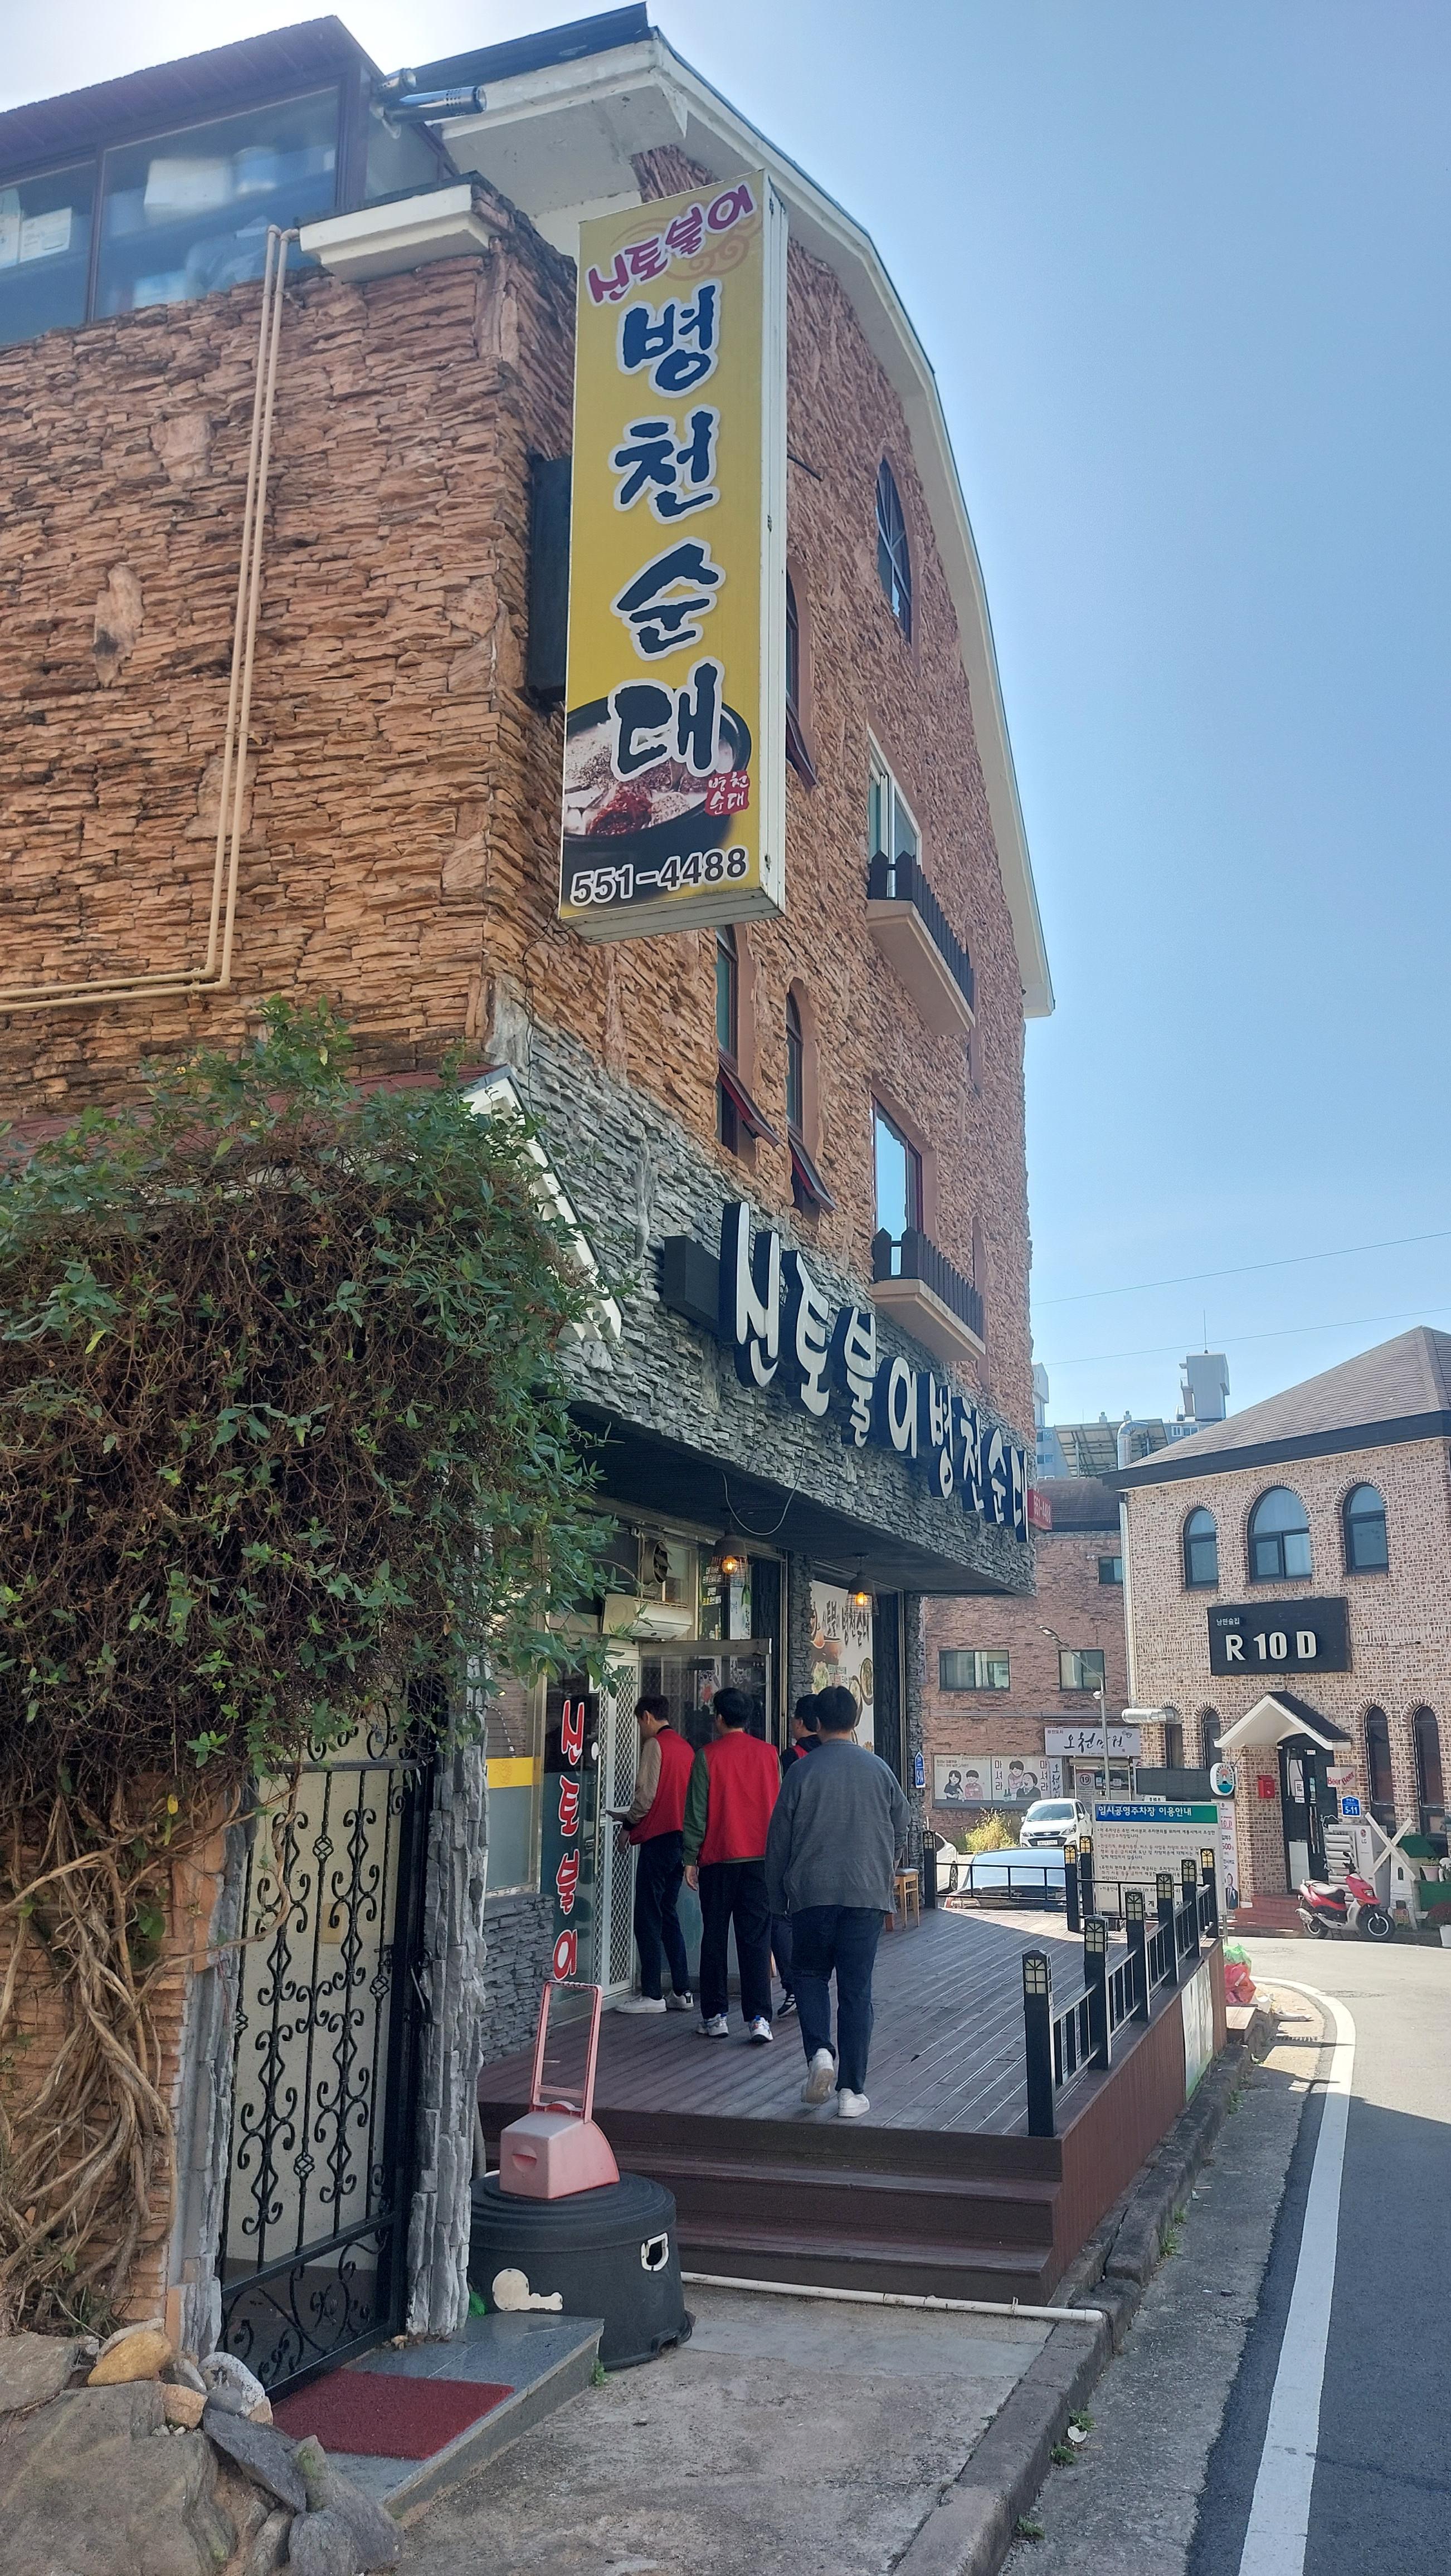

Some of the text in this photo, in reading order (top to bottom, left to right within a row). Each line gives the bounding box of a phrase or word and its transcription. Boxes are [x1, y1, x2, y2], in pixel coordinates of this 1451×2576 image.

[588, 184, 754, 303] 신토불이
[615, 285, 718, 775] 병천순대
[708, 772, 749, 792] 병천
[710, 791, 744, 814] 순대
[573, 850, 747, 904] 551-4488
[731, 1201, 1029, 1543] 신토불이 병천순대
[1226, 1631, 1317, 1661] R 10 D
[995, 1760, 1003, 1790] 마셔라
[1040, 1760, 1049, 1791] 마셔라
[1082, 1770, 1089, 1783] 19
[1327, 1777, 1341, 1785] Beer
[1098, 1806, 1192, 1817] 임시공영주차장 이용안내
[1345, 1806, 1357, 1814] 5-11
[553, 1700, 585, 1980] 신토불이
